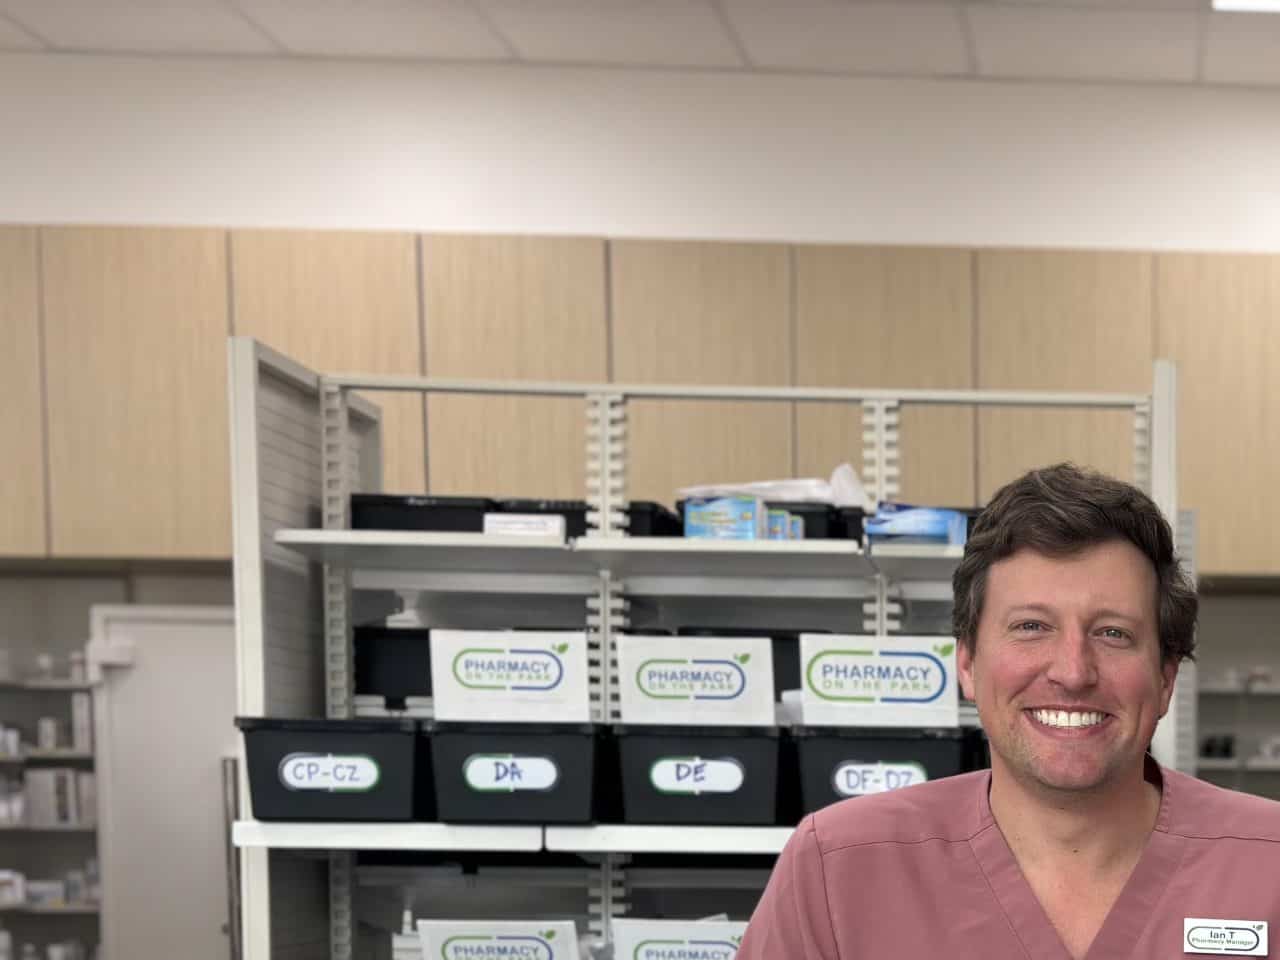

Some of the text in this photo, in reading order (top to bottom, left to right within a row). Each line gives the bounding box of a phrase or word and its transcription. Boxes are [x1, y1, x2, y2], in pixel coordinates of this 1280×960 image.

[464, 659, 551, 673] PHARMACY
[822, 664, 932, 681] PHARMACY
[648, 669, 733, 683] PHARMACY
[822, 679, 932, 692] ON THE PARK
[292, 762, 361, 782] CP-CZ
[494, 761, 523, 782] DA
[675, 761, 708, 782] DE
[1209, 930, 1236, 939] Ian T
[453, 945, 540, 957] PHARMACY
[645, 949, 731, 960] PHARMACY
